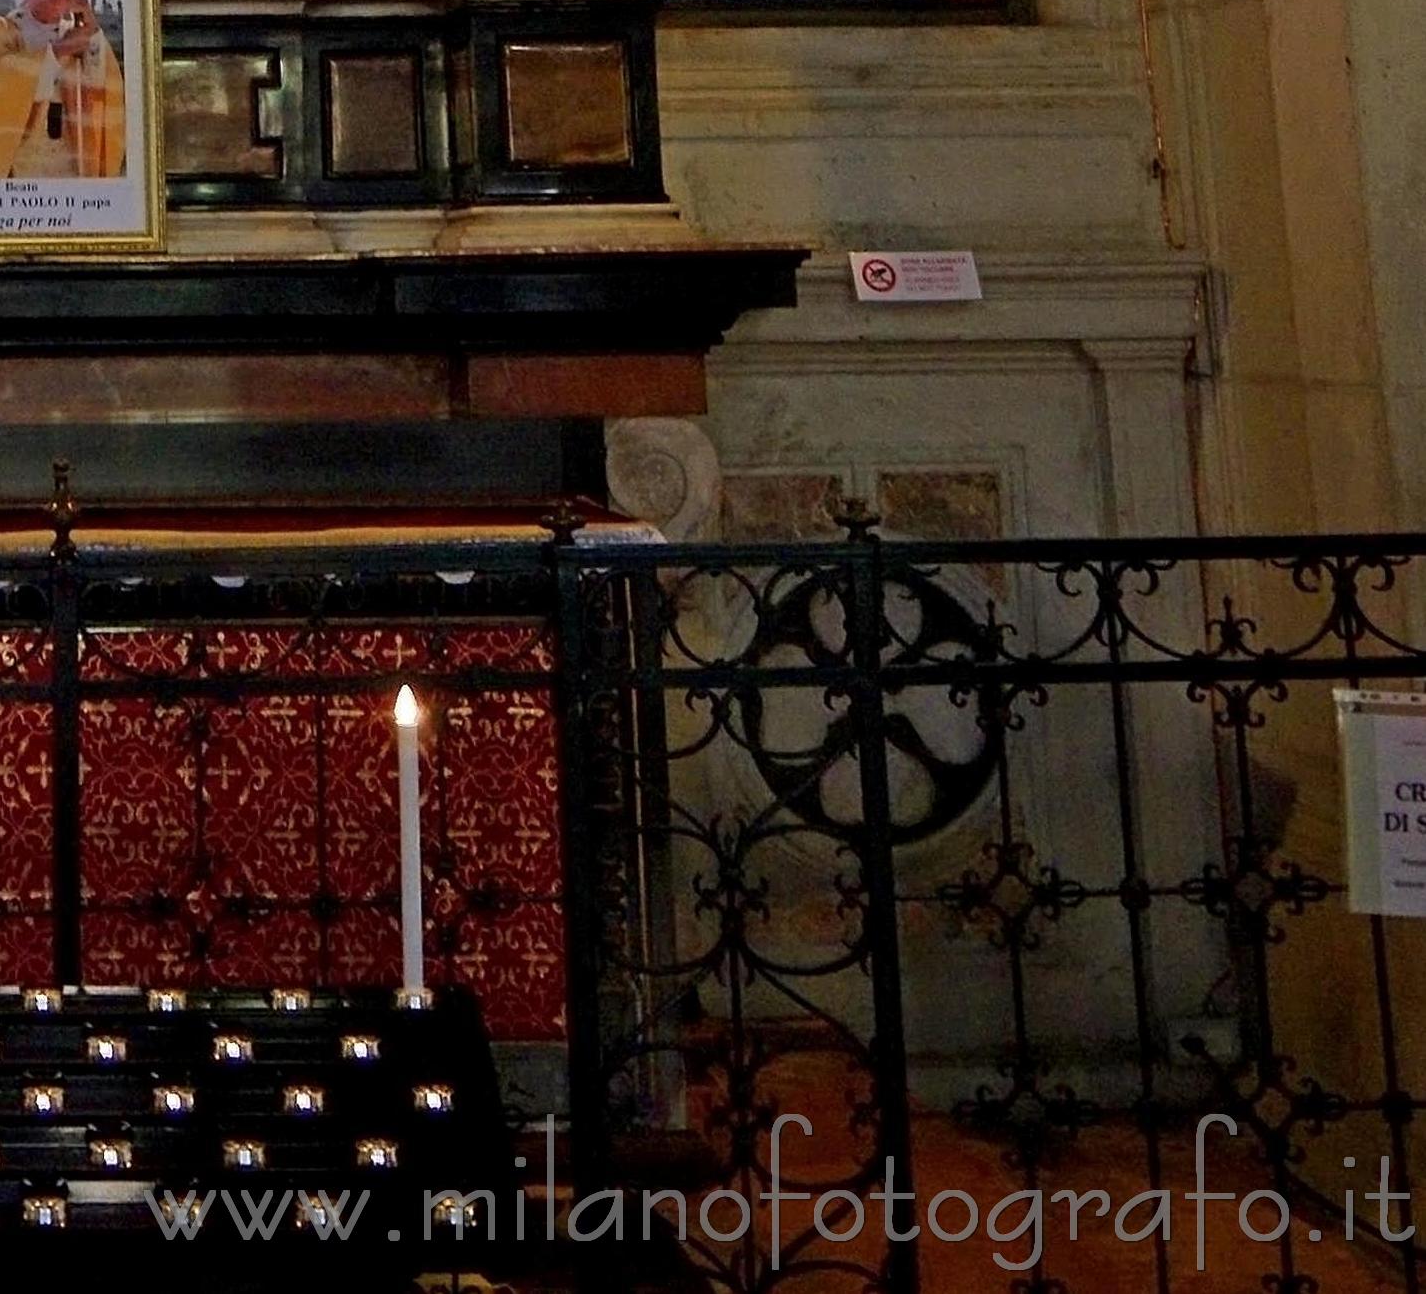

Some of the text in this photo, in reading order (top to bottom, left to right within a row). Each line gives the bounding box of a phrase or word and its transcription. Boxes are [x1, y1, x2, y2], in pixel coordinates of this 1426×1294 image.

[5, 182, 39, 193] Beato
[10, 196, 59, 209] PAOLO
[65, 196, 75, 209] II
[82, 198, 112, 210] papa
[17, 216, 42, 231] per
[47, 213, 73, 228] noi
[1384, 812, 1409, 833] DI
